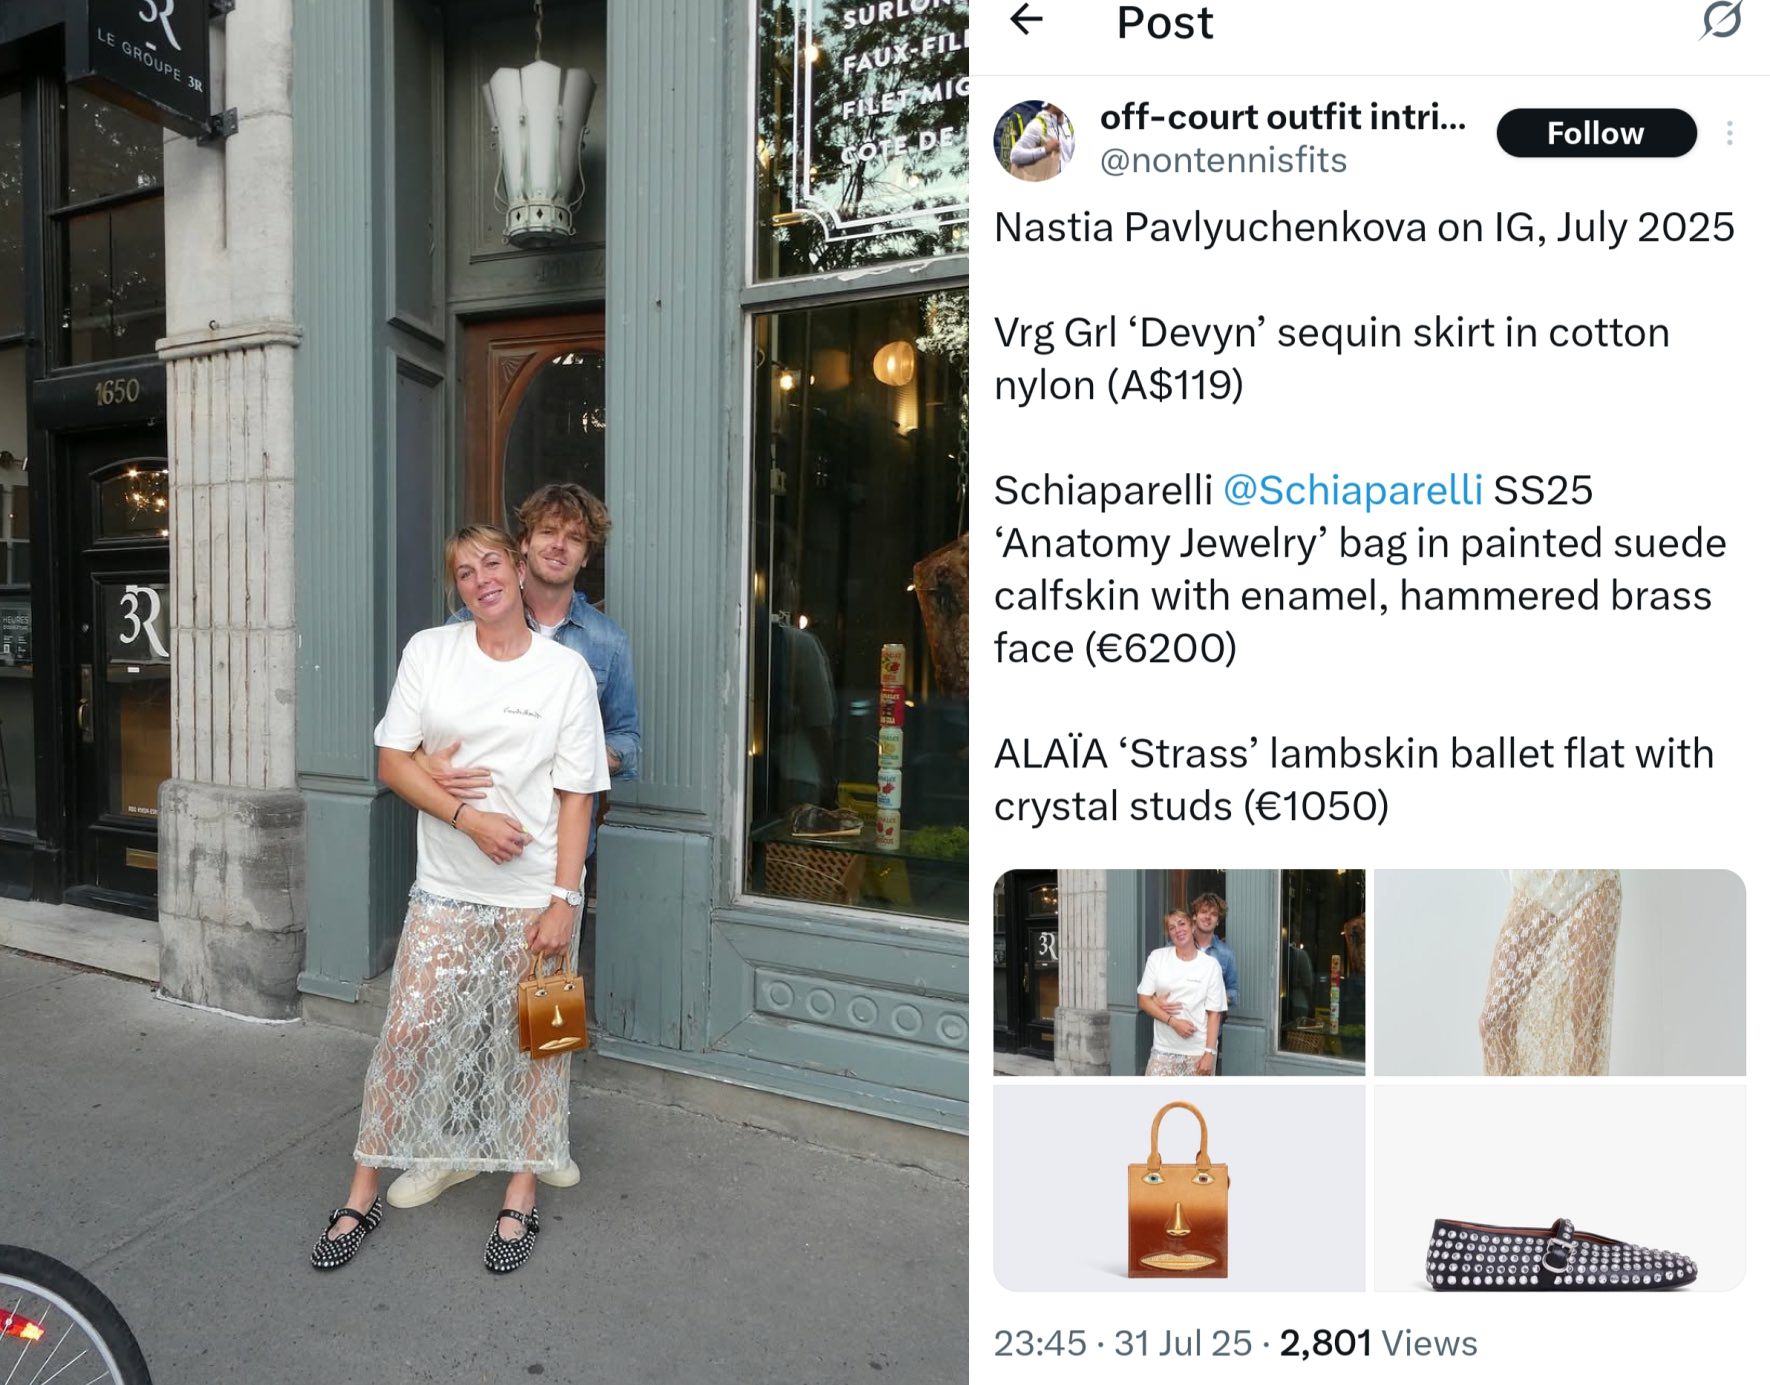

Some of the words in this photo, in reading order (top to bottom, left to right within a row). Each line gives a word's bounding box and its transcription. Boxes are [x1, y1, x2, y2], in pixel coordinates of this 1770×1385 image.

[97, 27, 116, 47] LE
[122, 41, 181, 82] GROUPE
[188, 75, 204, 93] 3R
[842, 89, 911, 120] FILET
[919, 126, 955, 151] DE
[95, 378, 140, 406] 1650
[119, 584, 170, 658] 3R
[1039, 931, 1058, 960] 3R
